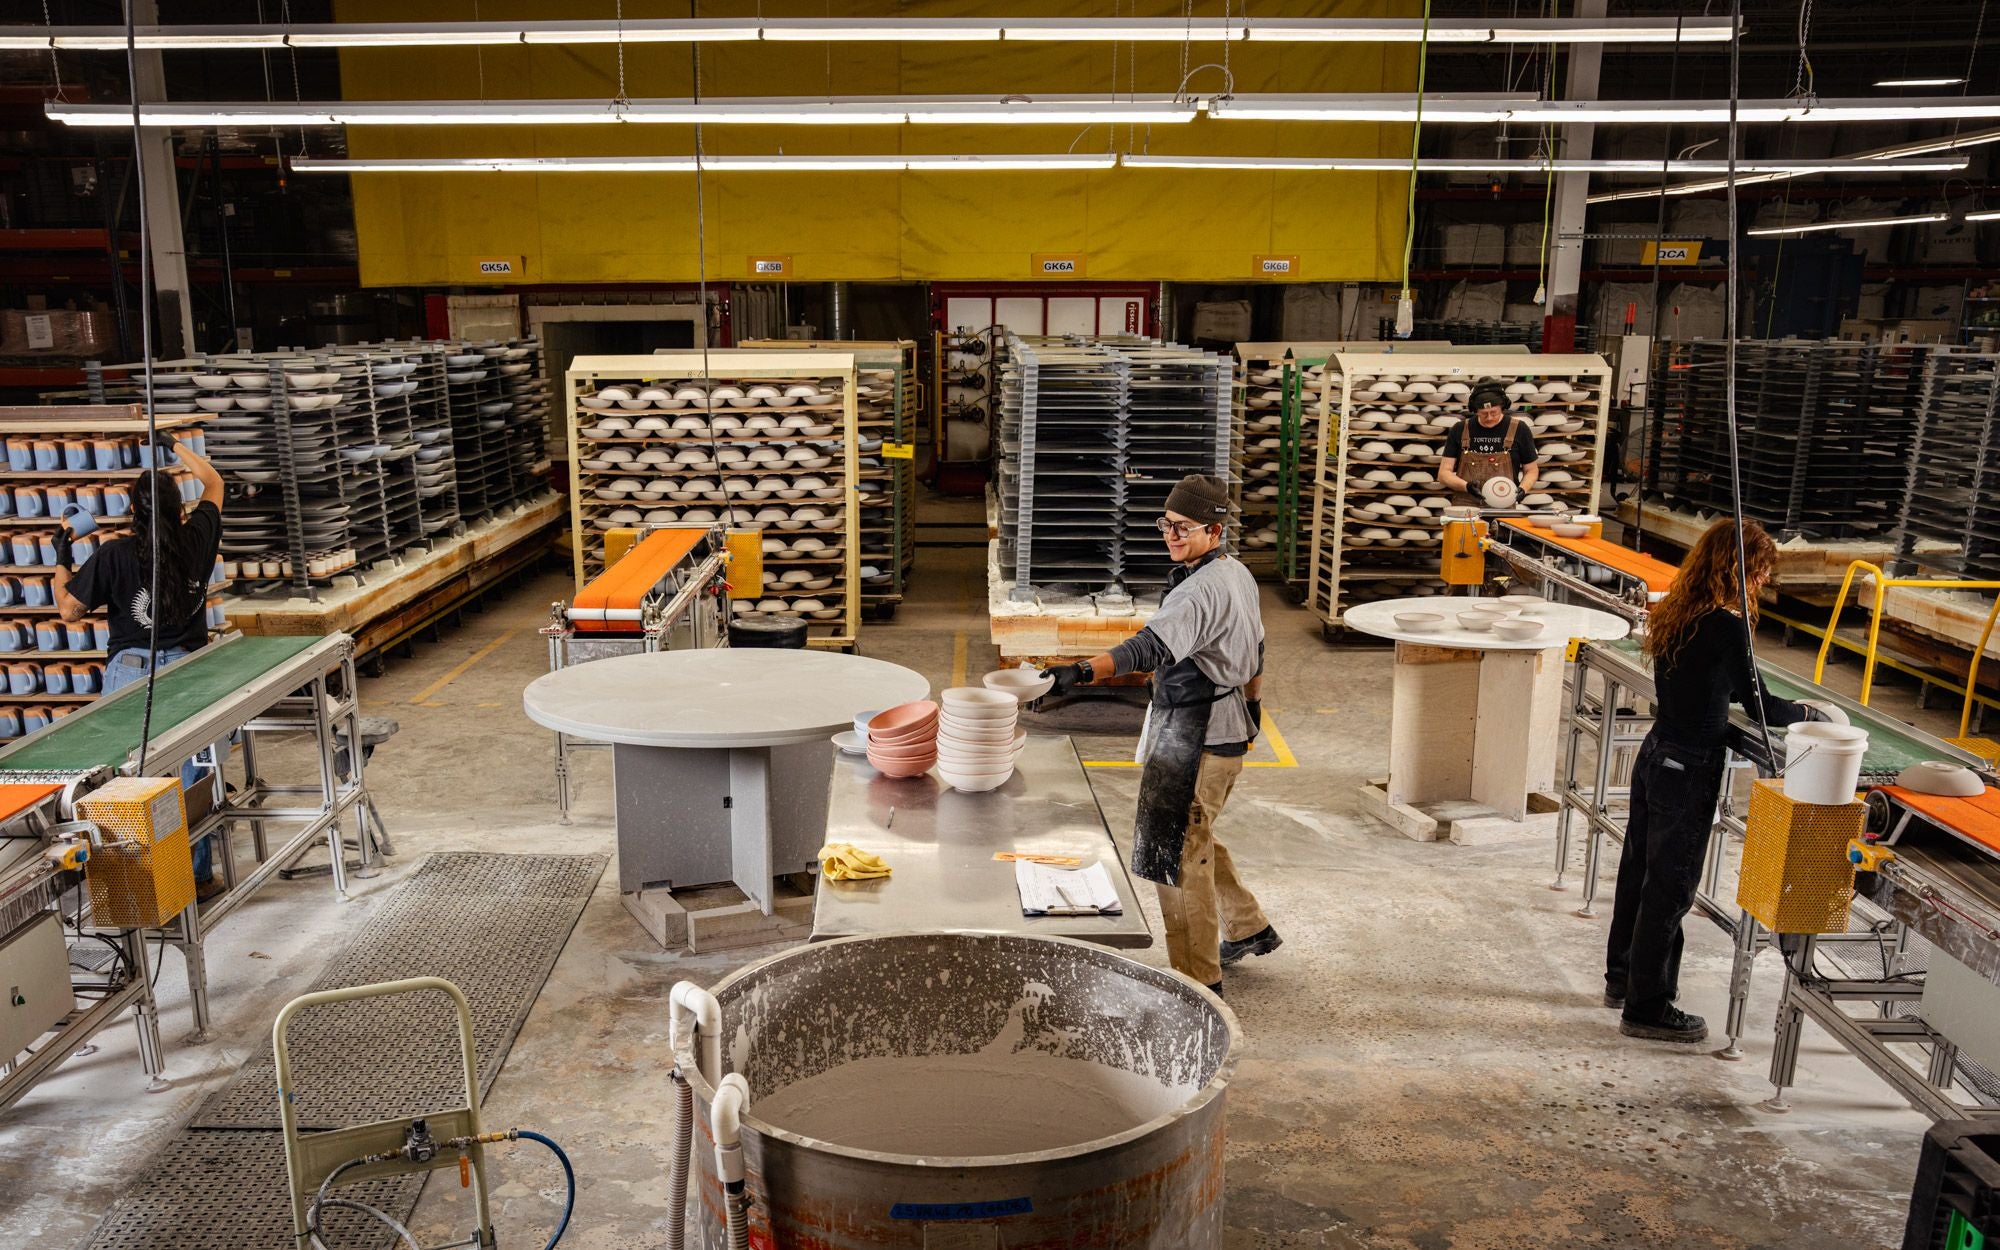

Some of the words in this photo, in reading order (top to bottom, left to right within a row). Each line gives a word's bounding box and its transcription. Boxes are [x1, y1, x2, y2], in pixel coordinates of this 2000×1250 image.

[1658, 250, 1685, 258] QCA
[481, 263, 510, 272] GK5A
[757, 263, 782, 271] GK5B
[1044, 262, 1073, 271] GK6A
[1263, 262, 1288, 270] GK6B
[1128, 303, 1137, 333] rjcsa.co
